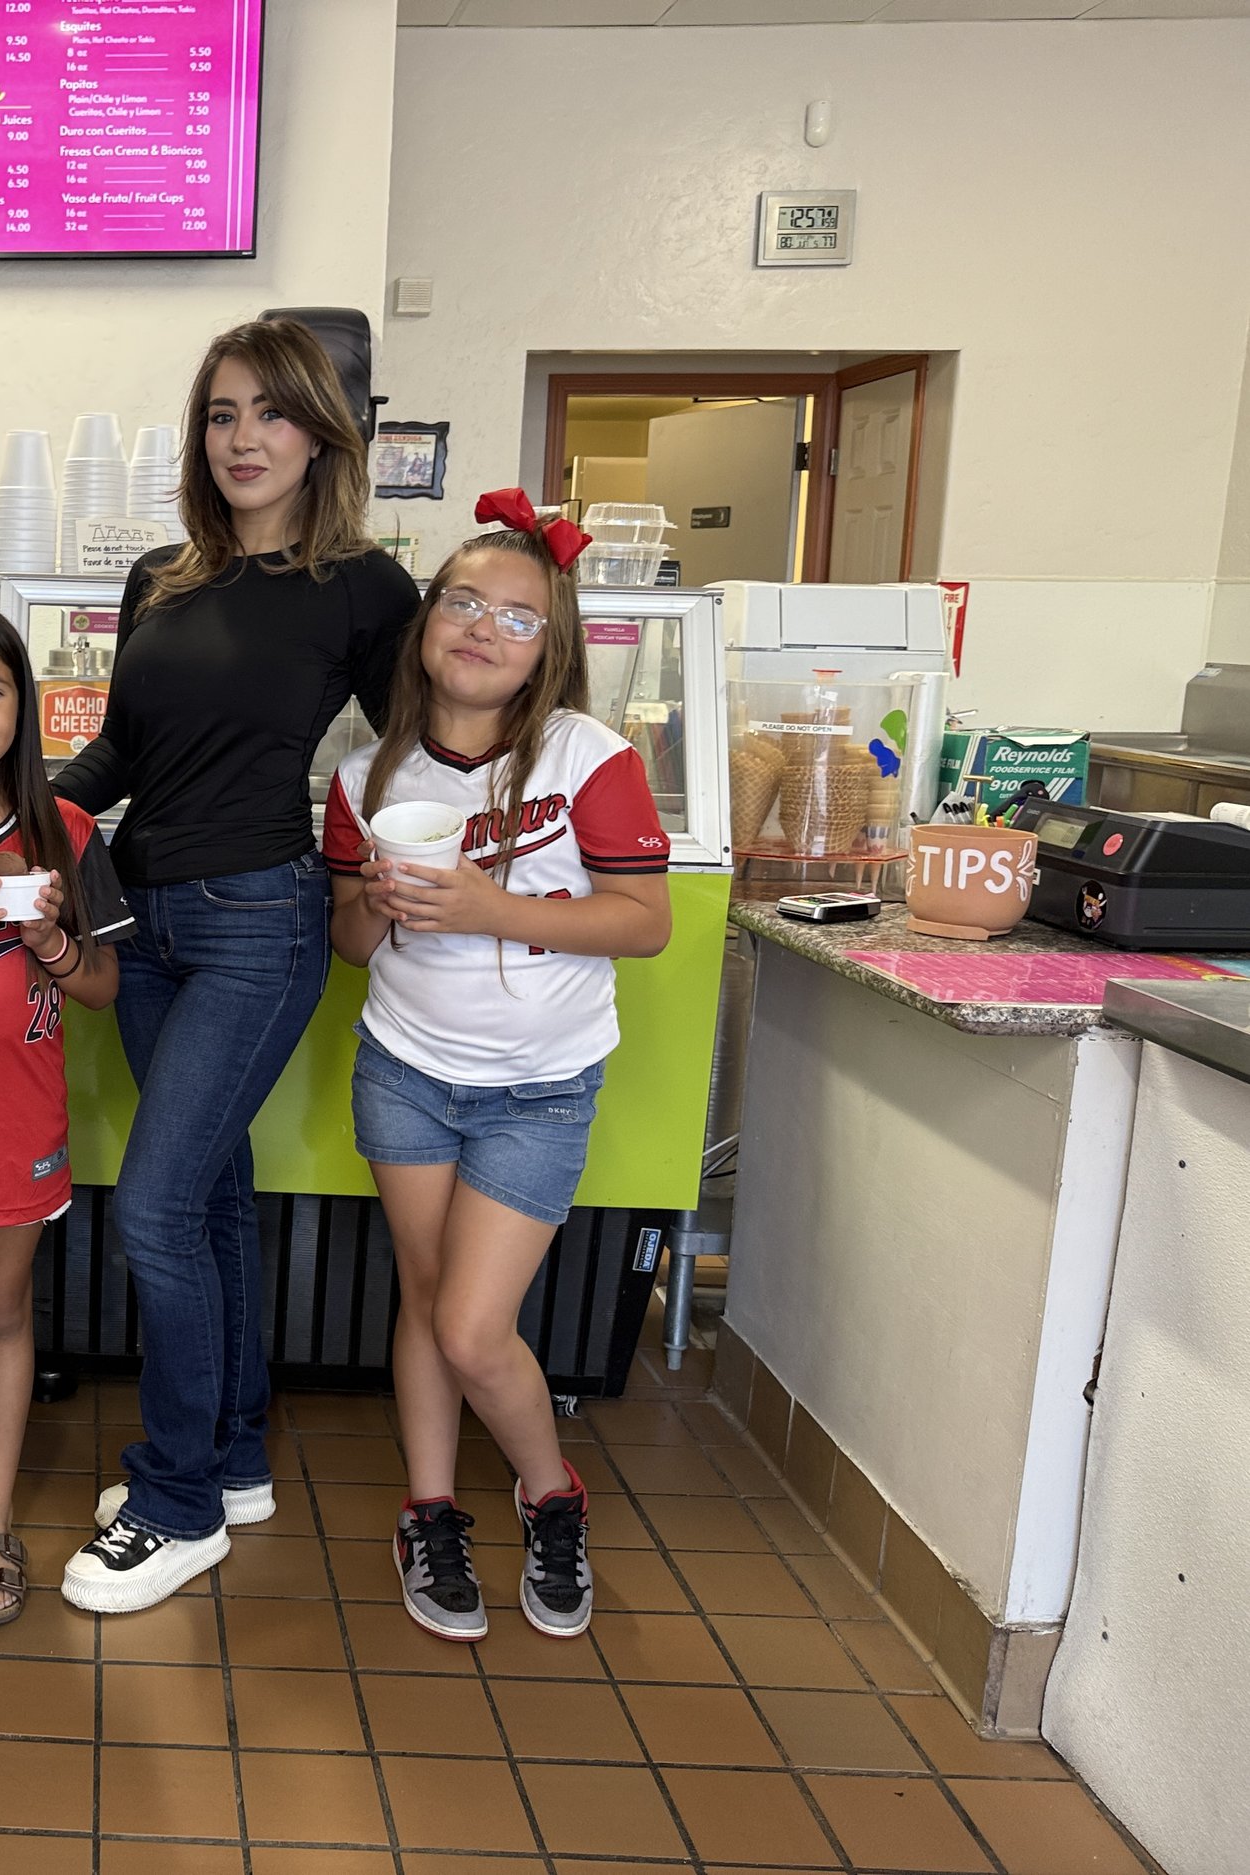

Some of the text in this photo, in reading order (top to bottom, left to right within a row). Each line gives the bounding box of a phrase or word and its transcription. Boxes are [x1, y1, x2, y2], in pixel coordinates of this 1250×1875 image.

[5, 3, 31, 13] 12.00
[60, 21, 102, 33] Esquites
[6, 36, 28, 46] 9.50
[67, 48, 75, 57] 8
[189, 47, 212, 57] 5.50
[6, 53, 31, 62] 14.50
[66, 62, 77, 72] 16
[189, 62, 212, 72] 9.50
[60, 79, 98, 91] Papitas
[188, 92, 210, 102] 3.50
[106, 107, 128, 116] Chile
[188, 106, 209, 116] 7.50
[2, 114, 32, 125] Juices
[60, 124, 211, 136] Duro con Cueritos 8.50
[7, 132, 29, 141] 9.00
[60, 145, 203, 156] Fresas Con Crema & Bionicos
[66, 161, 77, 170] 12
[185, 159, 207, 170] 9.00
[7, 165, 29, 175] 4.50
[7, 179, 29, 189] 6.50
[66, 175, 77, 184] 16
[185, 174, 211, 184] 10.50
[62, 193, 87, 204] Vaso
[87, 193, 102, 204] de
[134, 193, 159, 203] Fruit
[159, 193, 184, 205] Cups
[7, 209, 29, 219] 9.00
[65, 209, 76, 218] 16
[183, 208, 205, 218] 9.00
[6, 223, 31, 233] 14.00
[65, 222, 77, 232] 32
[182, 221, 207, 231] 12.00
[82, 544, 102, 553] Please
[125, 544, 146, 552] touch
[103, 557, 113, 566] de
[54, 697, 106, 714] NACHO
[992, 746, 1076, 765] Reynolds
[990, 766, 1052, 774] FOODSERVICE
[918, 845, 1014, 894] TIPS
[24, 978, 61, 1043] 28
[548, 1107, 571, 1116] DKNY
[642, 1233, 657, 1269] OJEDA
